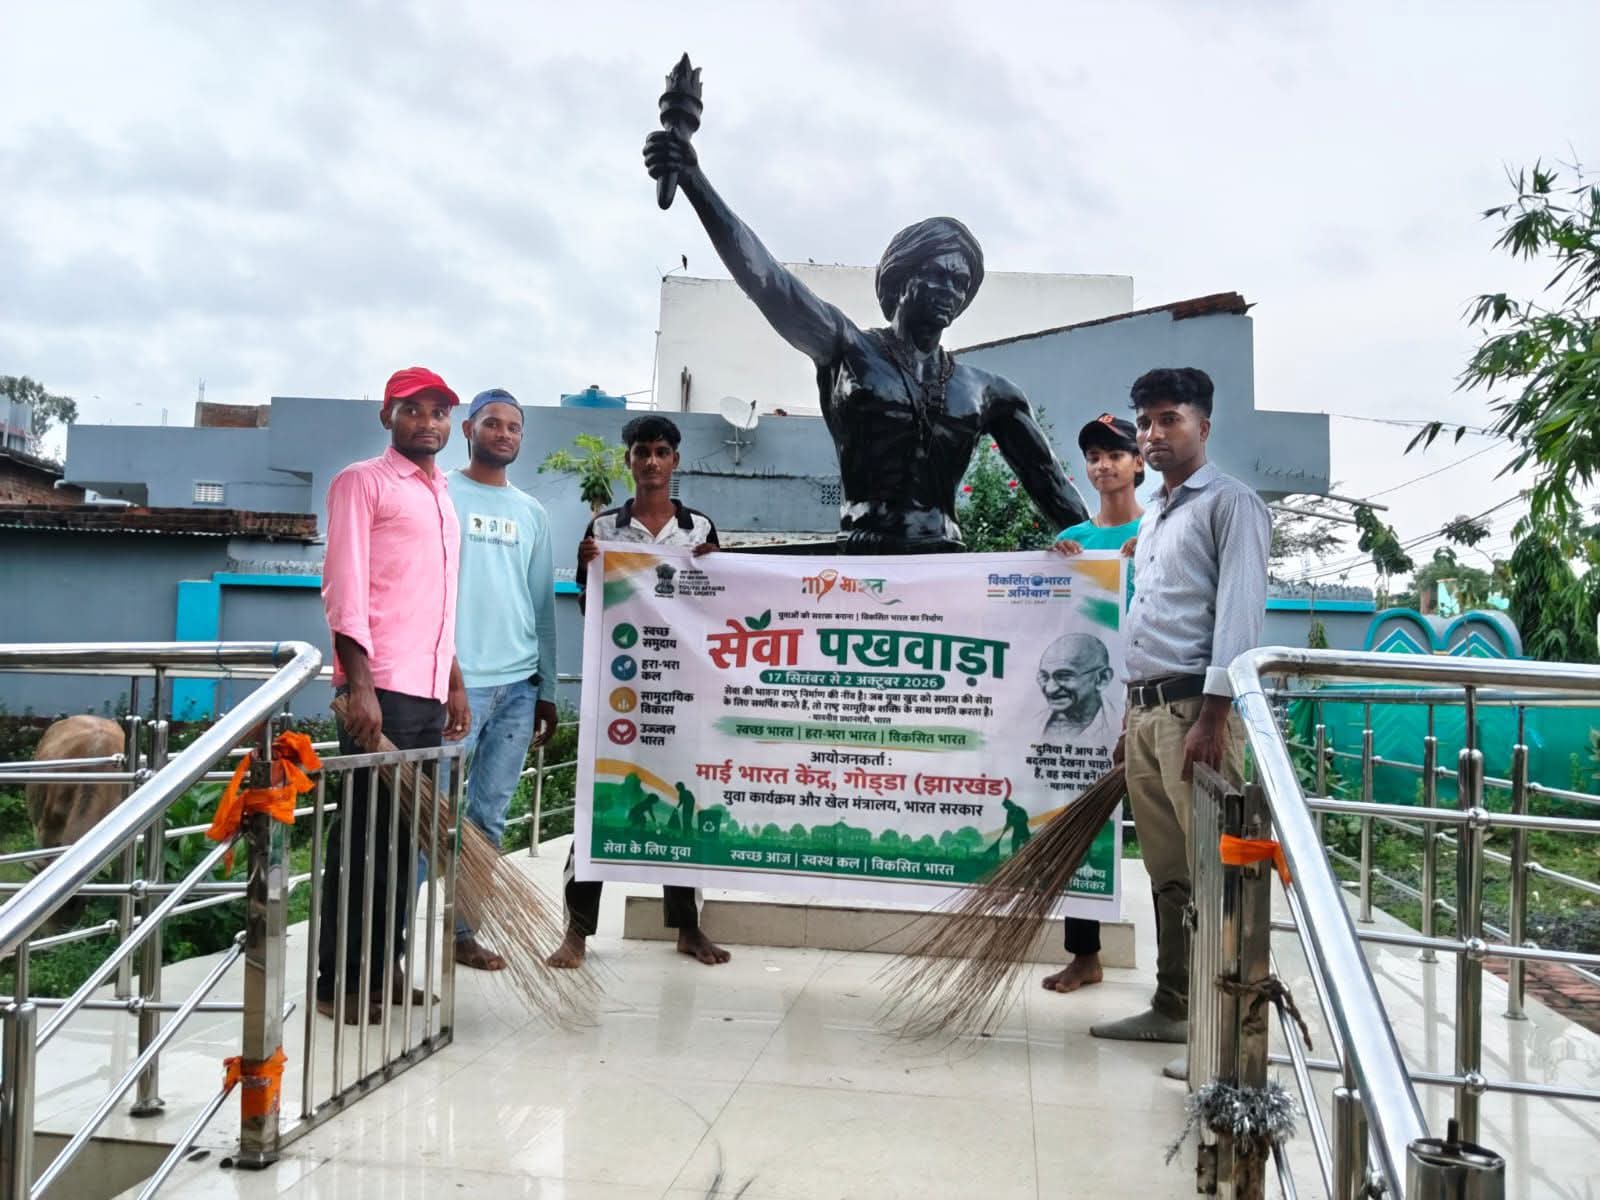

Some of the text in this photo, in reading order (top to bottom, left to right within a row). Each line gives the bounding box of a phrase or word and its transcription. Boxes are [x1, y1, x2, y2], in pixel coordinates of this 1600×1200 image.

[988, 574, 1072, 586] विकसित भारत
[1008, 586, 1050, 598] अभियान
[643, 625, 670, 637] स्वच्छ
[642, 638, 677, 652] समुदाय
[706, 618, 1010, 687] सेवा पखवाड़ा
[641, 659, 680, 670] हरा-भरा
[641, 671, 662, 681] कल
[768, 671, 938, 690] 17 सितंबर से 2 अक्टूबर 2026
[640, 690, 695, 705] सामुदायिक
[640, 702, 675, 715] विकास
[640, 736, 666, 746] भारत
[736, 724, 764, 736] स्वच्छ
[766, 726, 794, 737] भारत
[806, 728, 846, 740] हरा-भरा
[848, 730, 876, 742] भारत
[888, 730, 935, 744] विकसित
[938, 734, 967, 745] भारत
[1074, 746, 1093, 756] आप
[1096, 745, 1108, 757] जो
[810, 750, 884, 766] आयोजनकर्ता
[1026, 756, 1057, 767] बदलाव
[1059, 756, 1086, 768] देखना
[696, 758, 1012, 800] माई भारत केंद्र, गोड्डा (झारखंड)
[1046, 770, 1059, 780] वह
[722, 790, 984, 816] युवा कार्यक्रम और खेल मंत्रालय, भारत सरकार
[603, 839, 692, 861] सेवा के लिए युवा
[730, 850, 762, 862] स्वच्छ
[766, 852, 791, 864] आज
[802, 854, 834, 866] स्वस्थ
[836, 856, 860, 869] कल
[871, 856, 921, 873] विकसित
[924, 862, 955, 876] भारत
